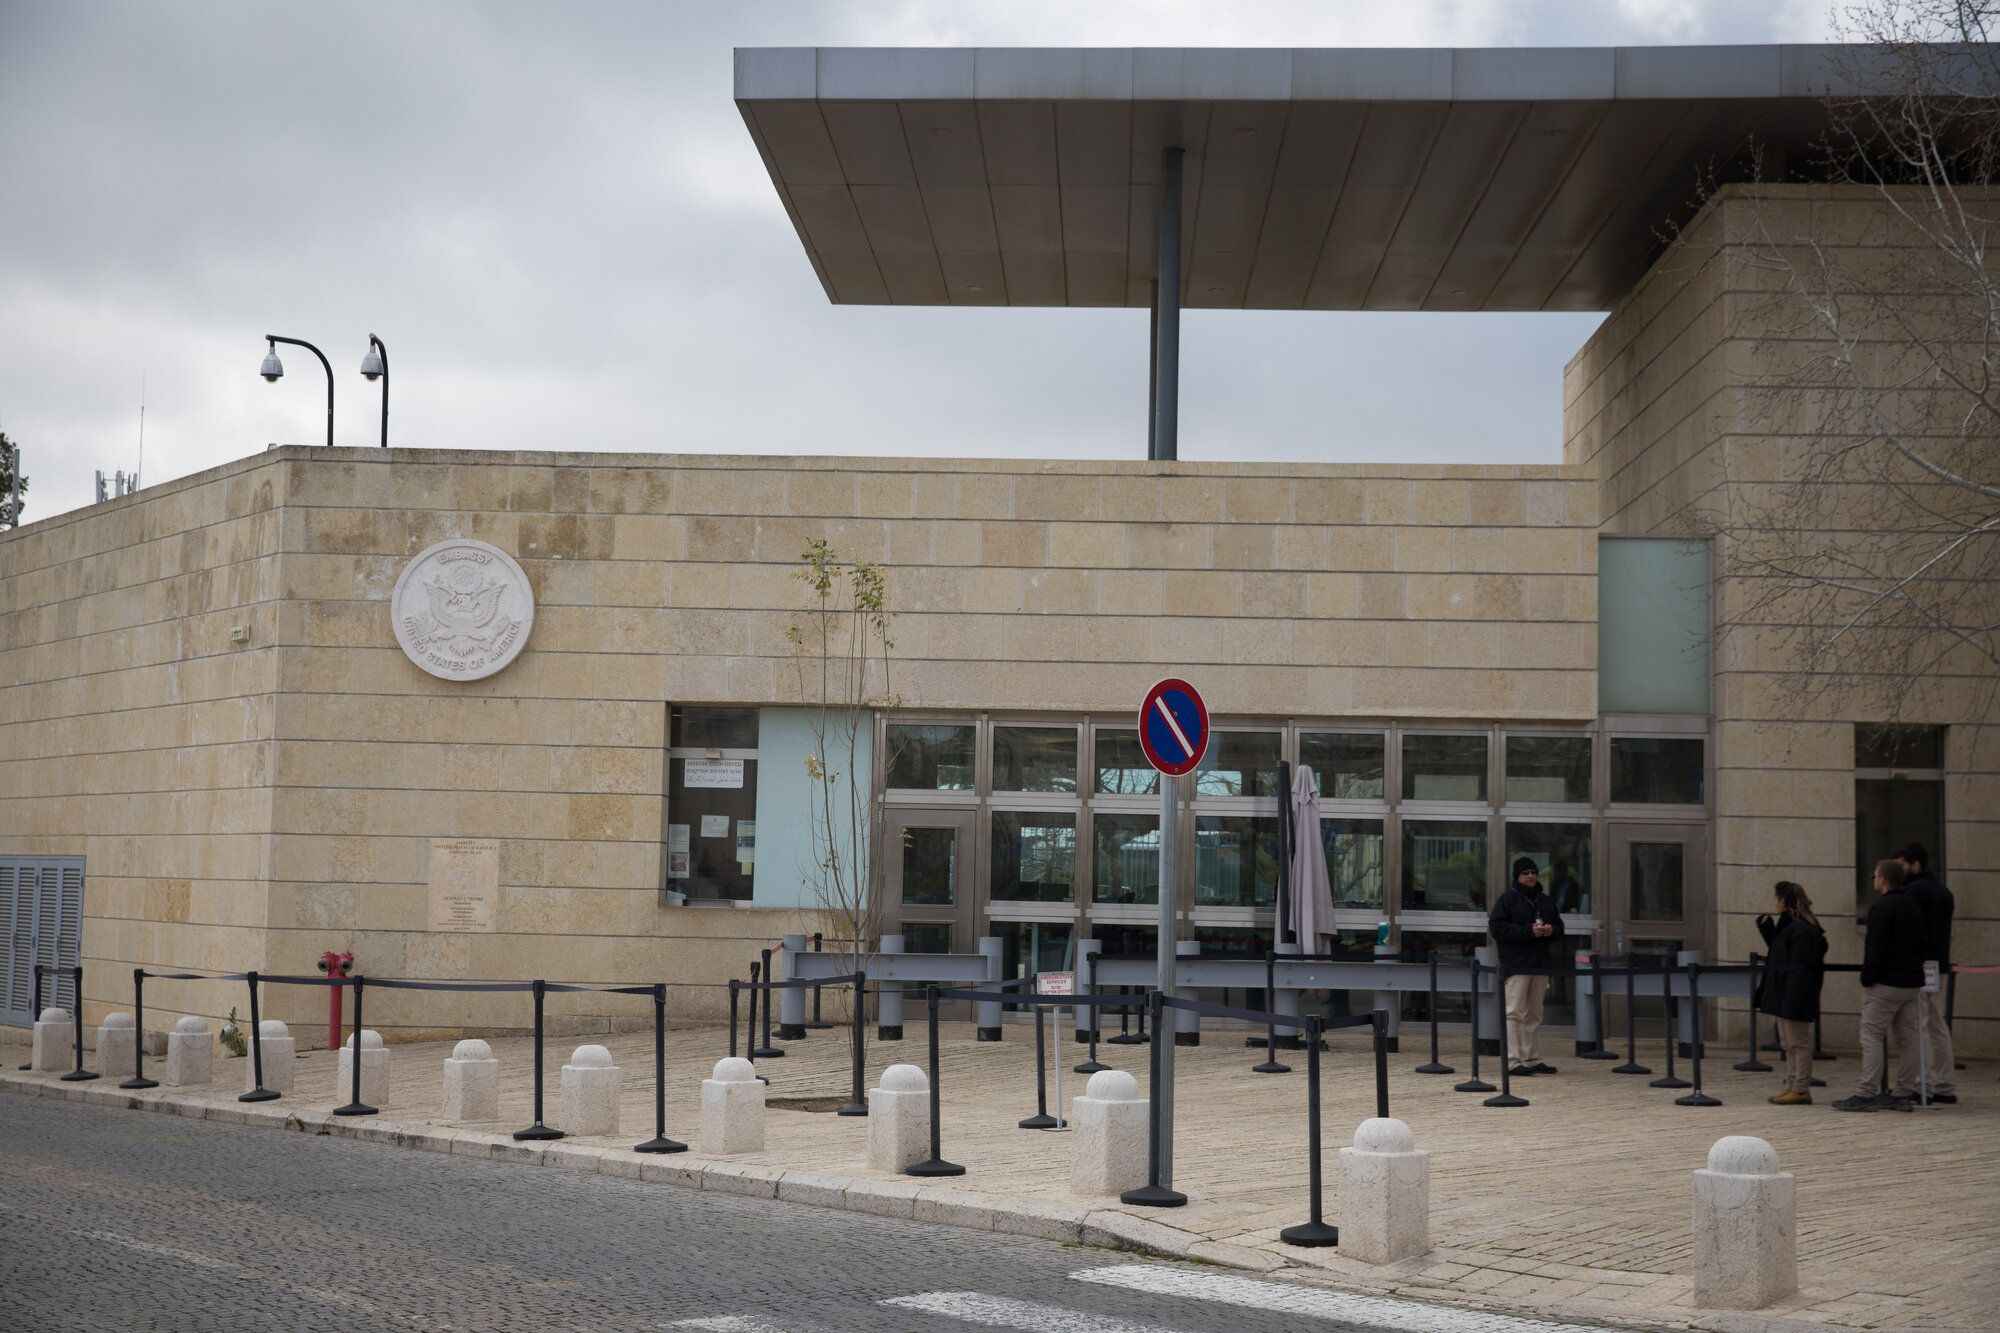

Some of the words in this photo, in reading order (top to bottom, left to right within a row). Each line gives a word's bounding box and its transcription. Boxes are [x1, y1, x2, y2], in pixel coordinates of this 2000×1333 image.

[438, 551, 493, 565] EMBASSY
[403, 616, 428, 654] UNITED
[426, 652, 466, 671] STATES
[469, 658, 485, 670] OF
[488, 619, 522, 664] AMERICA
